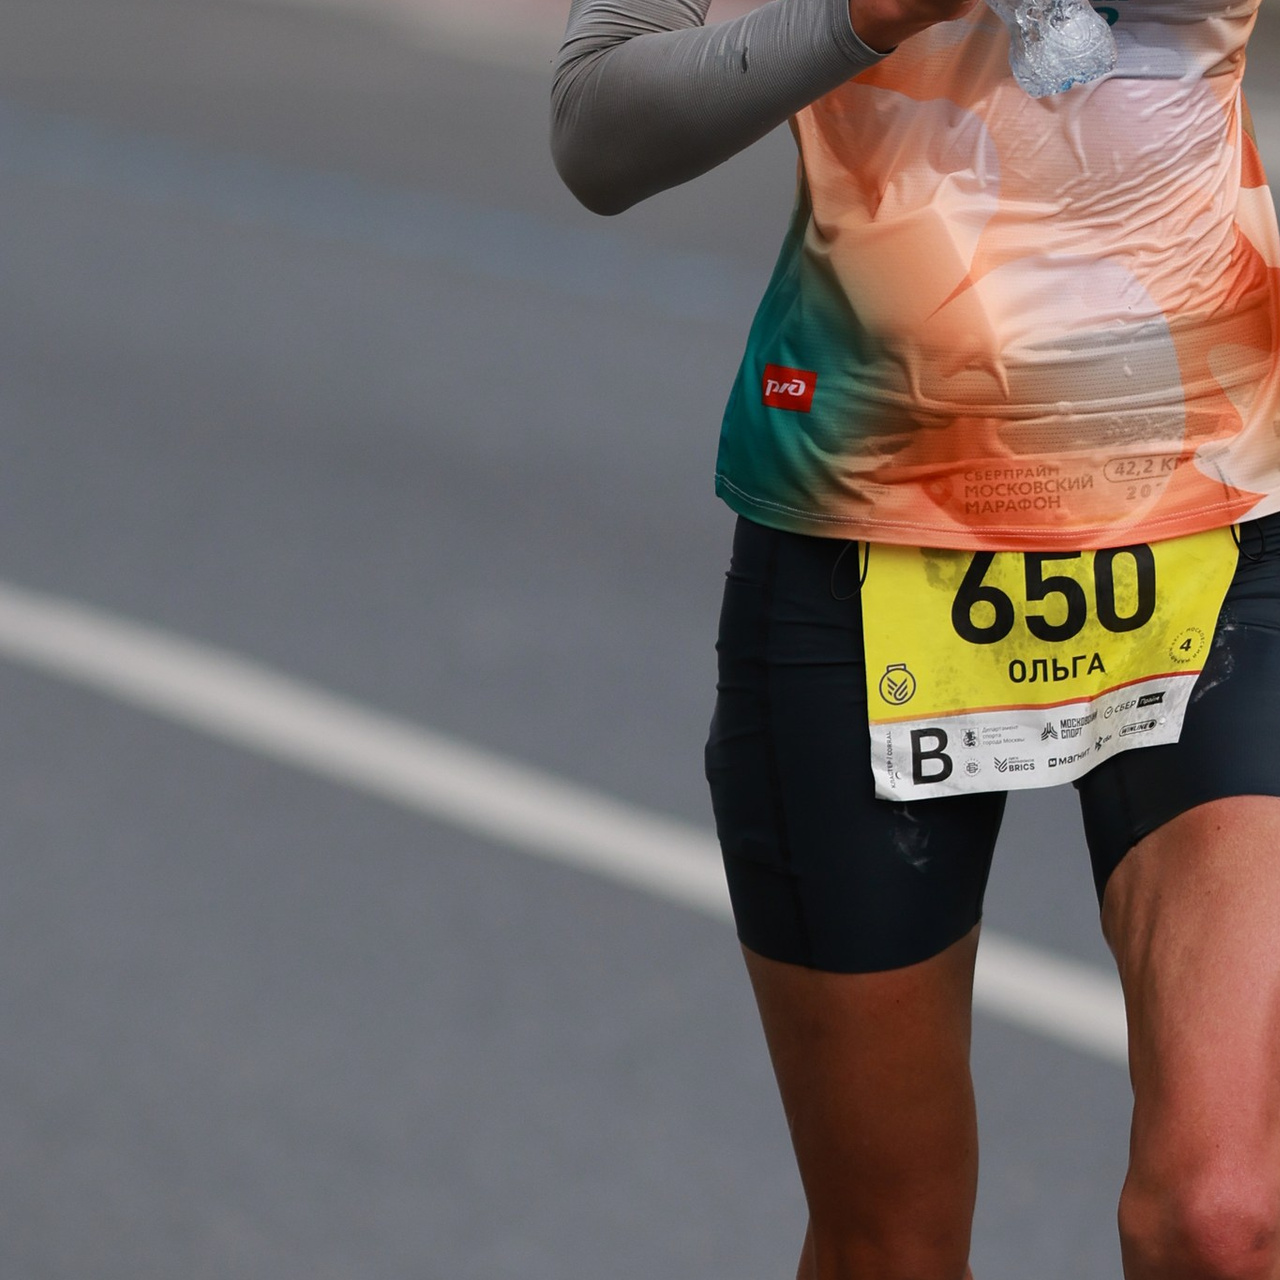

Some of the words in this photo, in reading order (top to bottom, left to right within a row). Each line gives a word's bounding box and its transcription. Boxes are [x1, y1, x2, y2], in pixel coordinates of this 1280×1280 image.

[964, 465, 1060, 483] СБЕРПРАЙМ
[1114, 459, 1154, 476] 42,2
[964, 473, 1093, 498] МОСКОВСКИЙ
[965, 496, 1061, 515] МАРАФОН
[952, 543, 1156, 644] 650
[1179, 638, 1192, 651] 4
[1009, 652, 1106, 683] ОЛЬГА
[1114, 700, 1137, 713] СБЕР
[1009, 762, 1035, 772] BRICS
